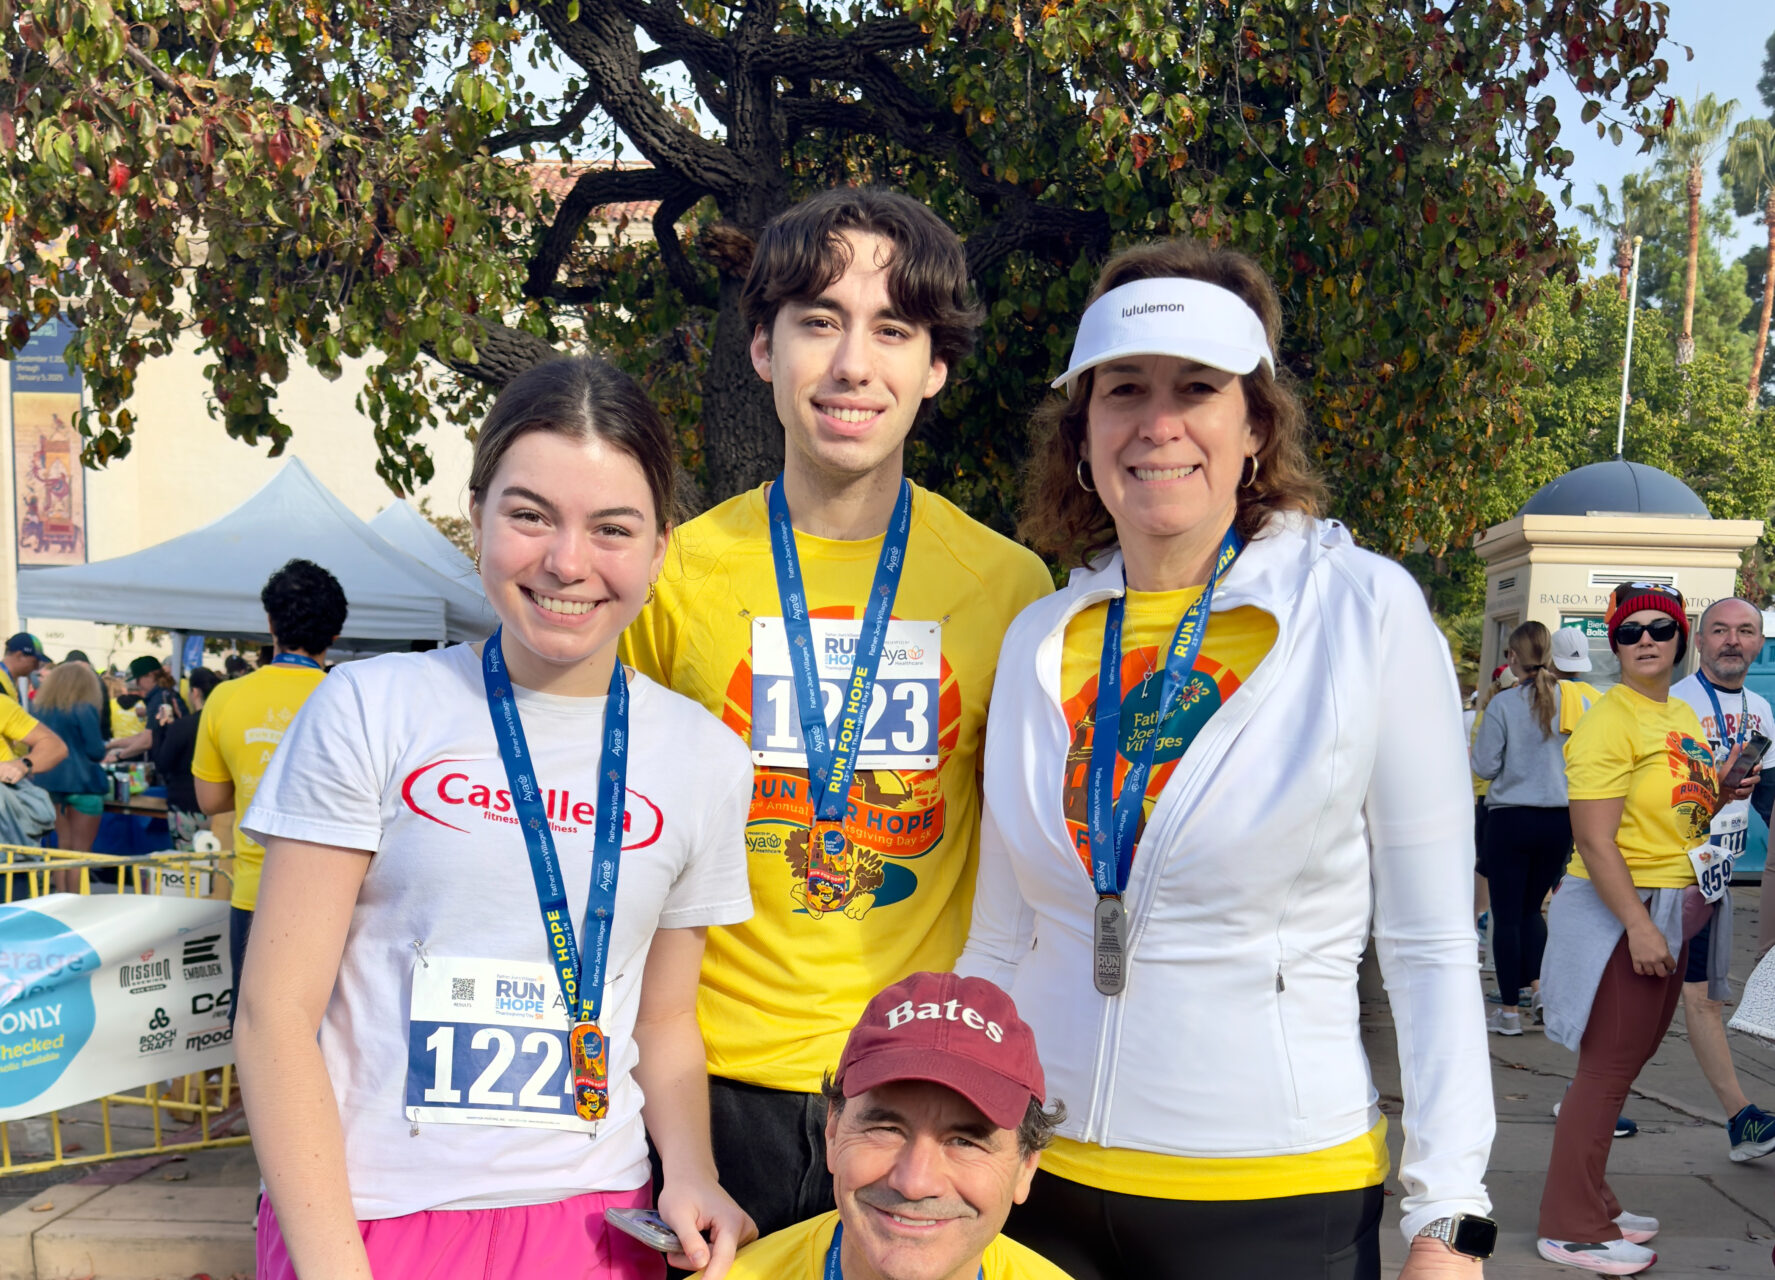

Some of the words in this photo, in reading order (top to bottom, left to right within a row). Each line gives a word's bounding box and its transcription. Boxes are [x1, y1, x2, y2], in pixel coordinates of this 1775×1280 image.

[1121, 302, 1184, 318] lululemon
[876, 597, 888, 621] Villages
[1540, 593, 1588, 604] BALBOA
[1594, 594, 1609, 604] PA
[792, 602, 803, 621] Aya
[873, 620, 882, 637] Joe's
[1174, 621, 1196, 658] RUN
[1187, 594, 1204, 617] FO
[824, 637, 860, 654] RU
[868, 636, 879, 657] Father
[880, 646, 908, 666] Aya
[828, 653, 856, 665] HO
[766, 679, 929, 752] 1223
[828, 757, 847, 793] RUN
[838, 718, 856, 752] FOR
[847, 666, 868, 713] HOPE
[847, 745, 856, 770] Annual
[852, 704, 867, 746] Thanksgiving
[1128, 727, 1161, 741] Joe
[611, 737, 624, 757] Aya
[1126, 737, 1183, 752] Vilges
[611, 782, 619, 808] Villages
[1680, 784, 1698, 795] RUN
[437, 772, 631, 836] Caslle
[766, 801, 809, 816] Annual
[483, 811, 519, 825] fitness
[548, 822, 578, 834] llness
[610, 806, 618, 826] Joe's
[866, 807, 935, 835] HOPE
[537, 829, 550, 857] Villages
[608, 825, 617, 843] Father
[846, 824, 893, 847] sgiving
[896, 835, 917, 847] Day
[920, 829, 932, 843] 5K
[1720, 831, 1745, 854] 911
[544, 856, 554, 877] Joe's
[547, 876, 558, 896] Father
[600, 869, 613, 892] Aya
[1702, 859, 1731, 896] 859
[547, 909, 570, 962] HOPE
[597, 920, 606, 947] Villages
[595, 946, 603, 966] Joe's
[1098, 955, 1120, 968] RUN
[183, 963, 223, 981] EMBOLDEN
[592, 965, 600, 987] Father
[1099, 967, 1120, 975] HOPE
[495, 979, 545, 1001] RUN
[562, 967, 578, 1005] FOR
[500, 998, 545, 1013] HOPE
[0, 1003, 62, 1035] ONLY
[885, 999, 1004, 1043] Bates
[0, 1033, 64, 1060] hecked
[140, 1029, 177, 1045] BOOCH
[140, 1038, 174, 1053] CRAFT
[424, 1025, 574, 1109] 122
